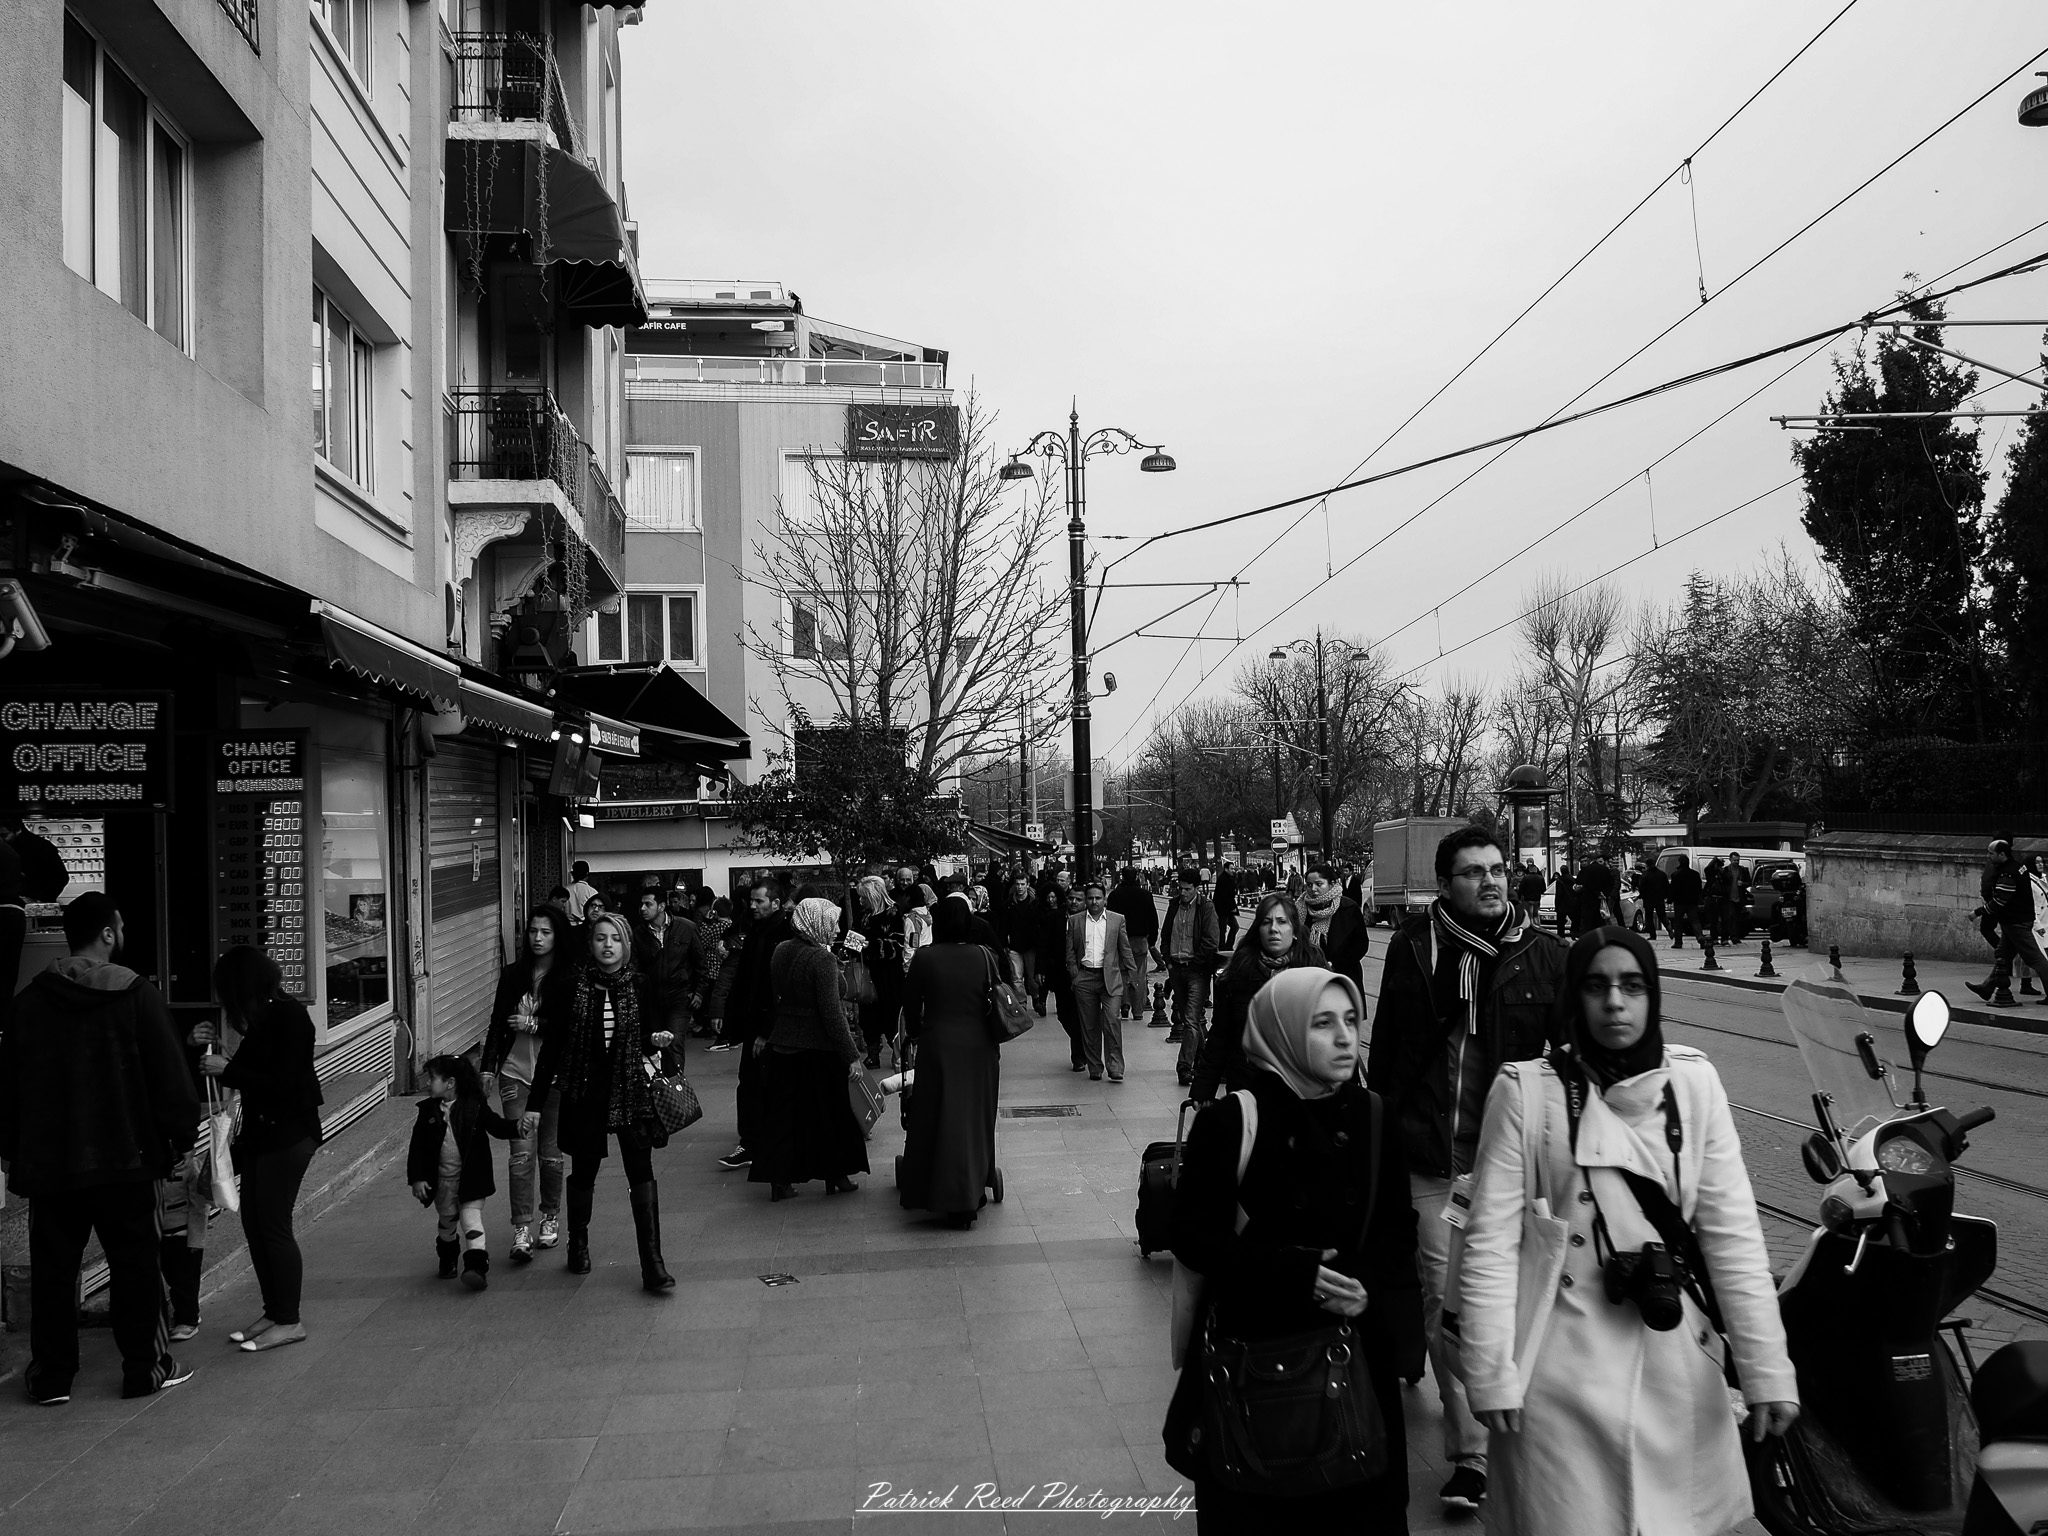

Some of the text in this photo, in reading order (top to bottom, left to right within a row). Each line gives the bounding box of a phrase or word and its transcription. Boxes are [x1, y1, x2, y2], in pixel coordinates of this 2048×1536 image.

[664, 322, 687, 330] CAFE
[1, 701, 159, 731] CHANGE
[222, 741, 296, 756] CHANGE
[13, 743, 147, 772] OFFICE
[228, 760, 291, 774] OFFICE
[18, 783, 143, 801] NO COMMISSION
[217, 778, 303, 792] NO COMMISSION
[605, 806, 676, 818] JEWELLERY
[1568, 1080, 1581, 1118] SONY
